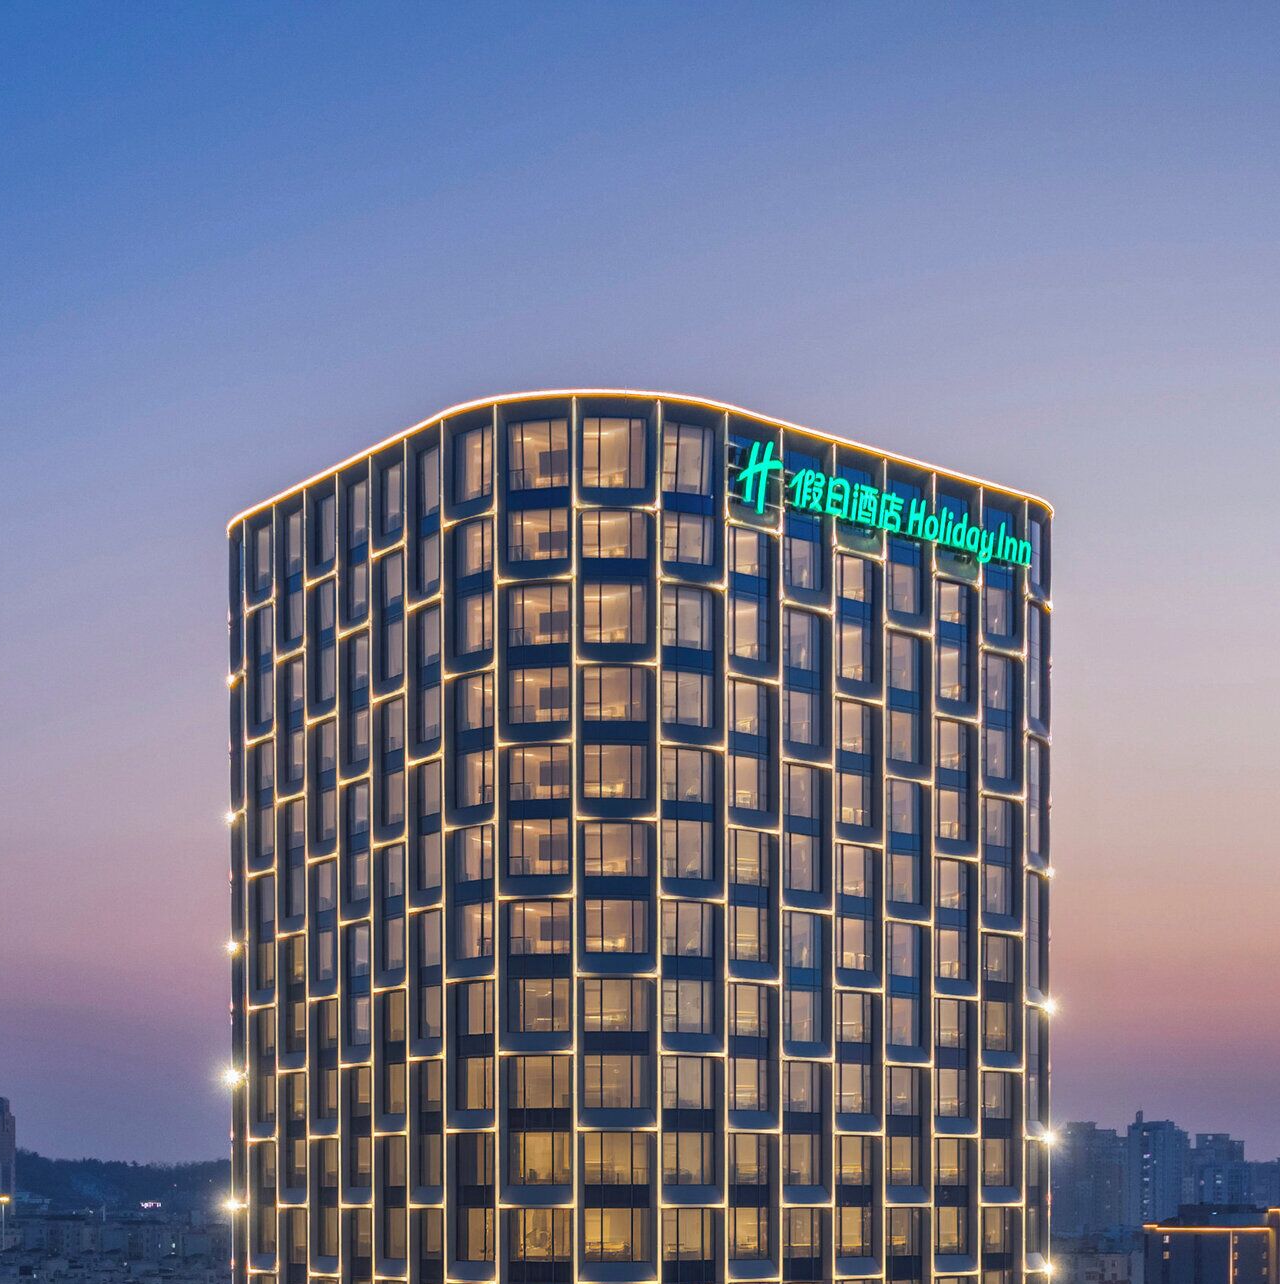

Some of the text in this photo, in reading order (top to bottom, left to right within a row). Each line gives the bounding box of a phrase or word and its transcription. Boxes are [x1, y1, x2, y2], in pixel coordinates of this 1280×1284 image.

[788, 468, 905, 534] 假日酒店
[906, 498, 995, 564] Holiday
[995, 521, 1032, 565] Inn
